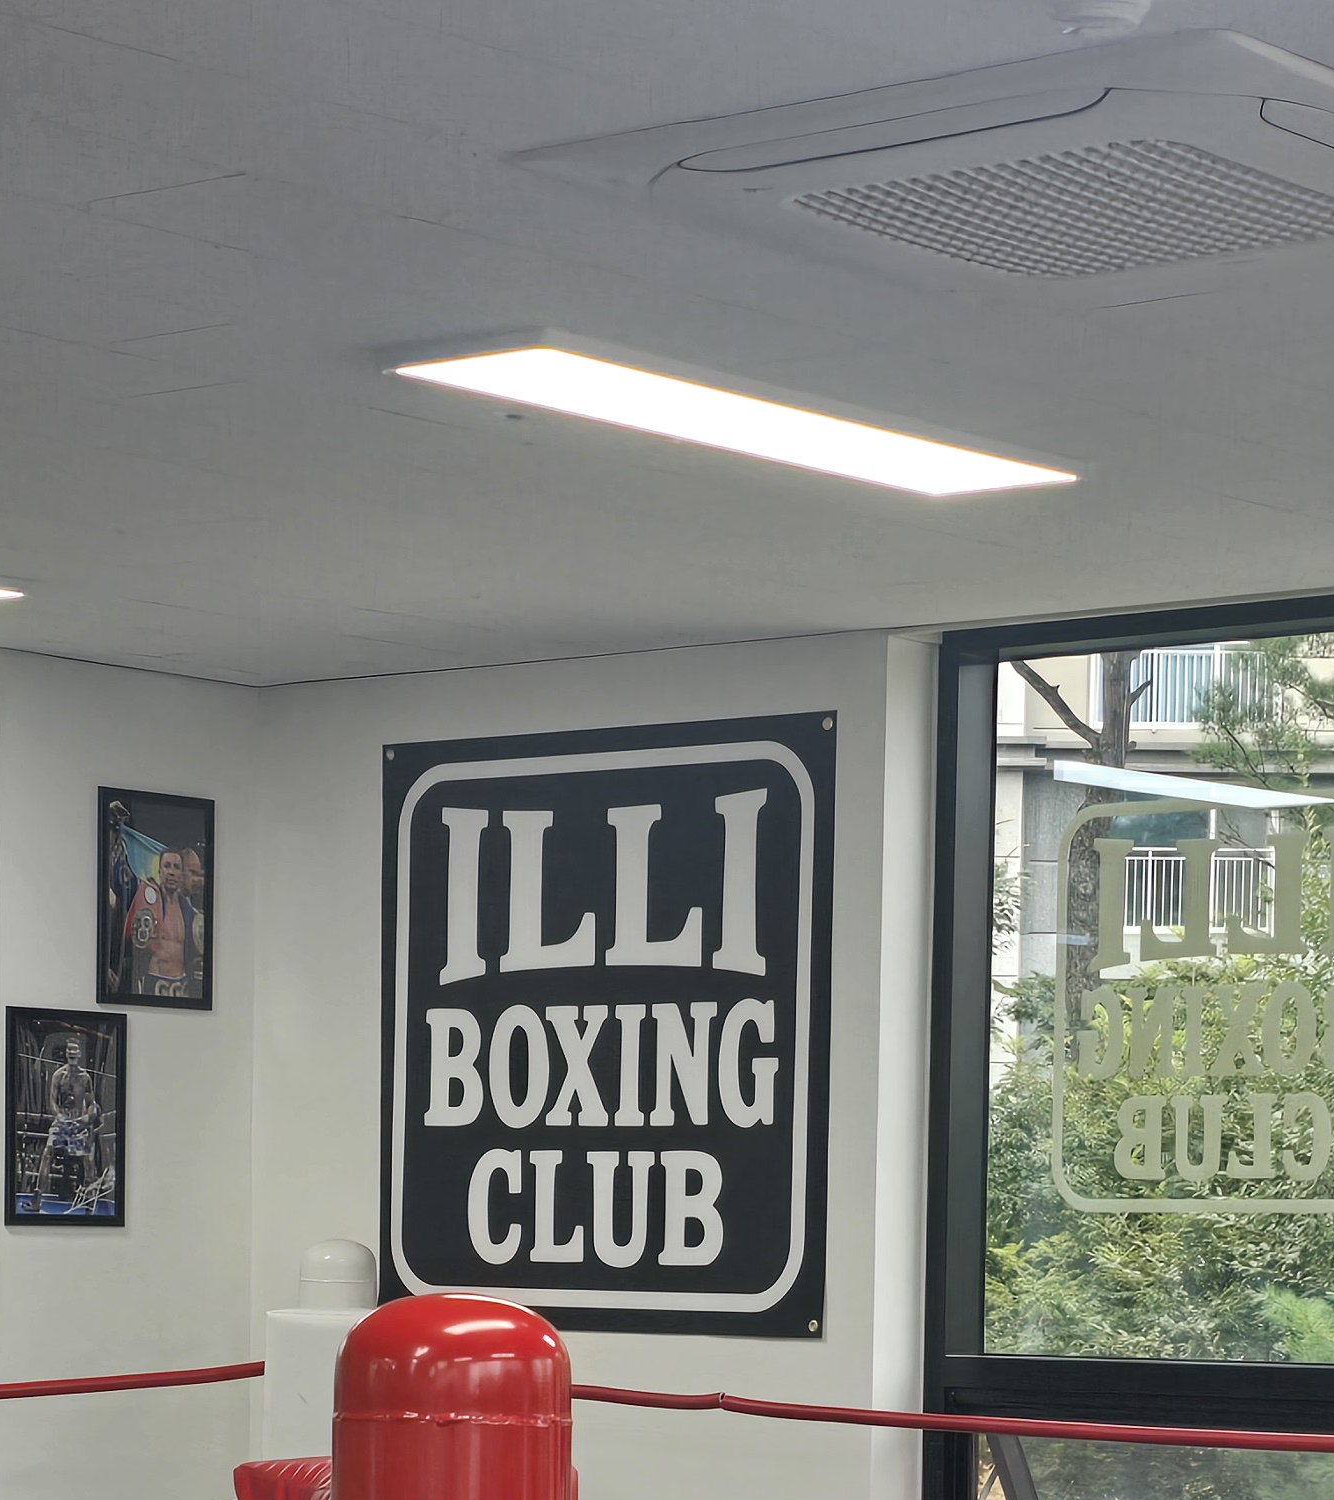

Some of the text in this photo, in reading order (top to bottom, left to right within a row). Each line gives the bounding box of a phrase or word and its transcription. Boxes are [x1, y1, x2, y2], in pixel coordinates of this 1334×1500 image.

[438, 787, 768, 986] ILLI
[423, 998, 779, 1129] BOXING
[467, 1147, 724, 1269] CLUB
